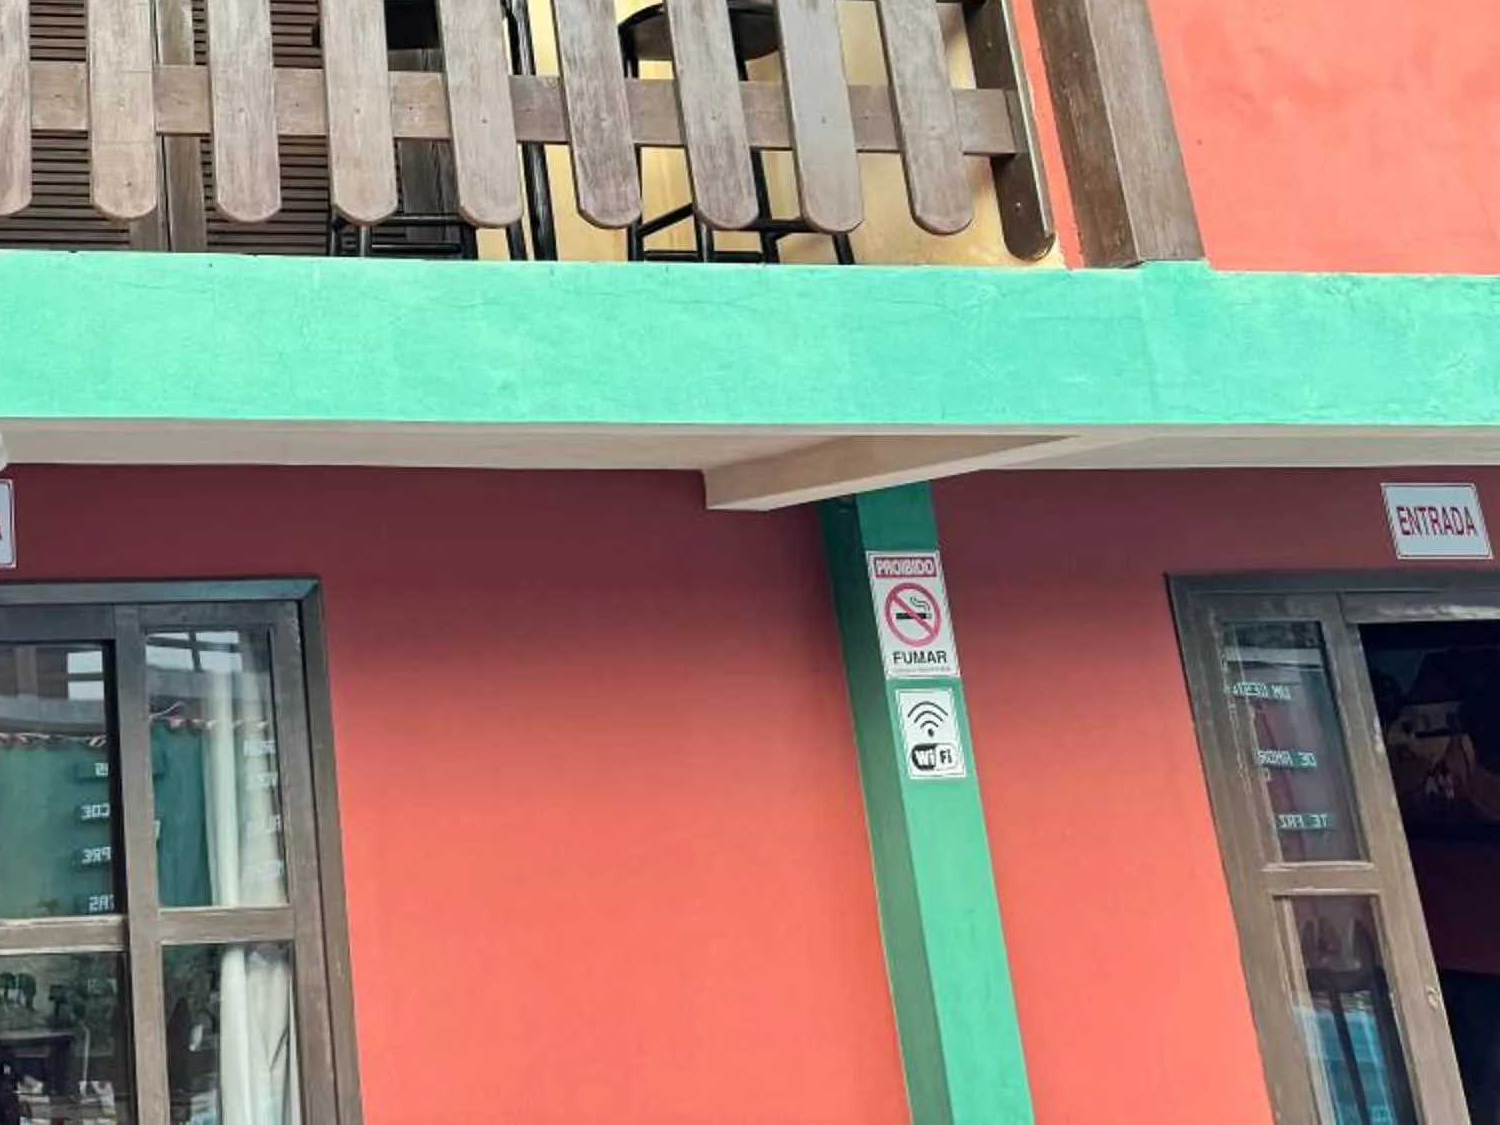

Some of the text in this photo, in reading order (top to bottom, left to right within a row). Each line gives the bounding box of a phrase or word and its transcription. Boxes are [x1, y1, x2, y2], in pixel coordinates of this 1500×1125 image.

[1395, 506, 1479, 536] ENTRADA
[875, 558, 935, 575] PROIBIDO
[893, 651, 948, 664] FUMAR
